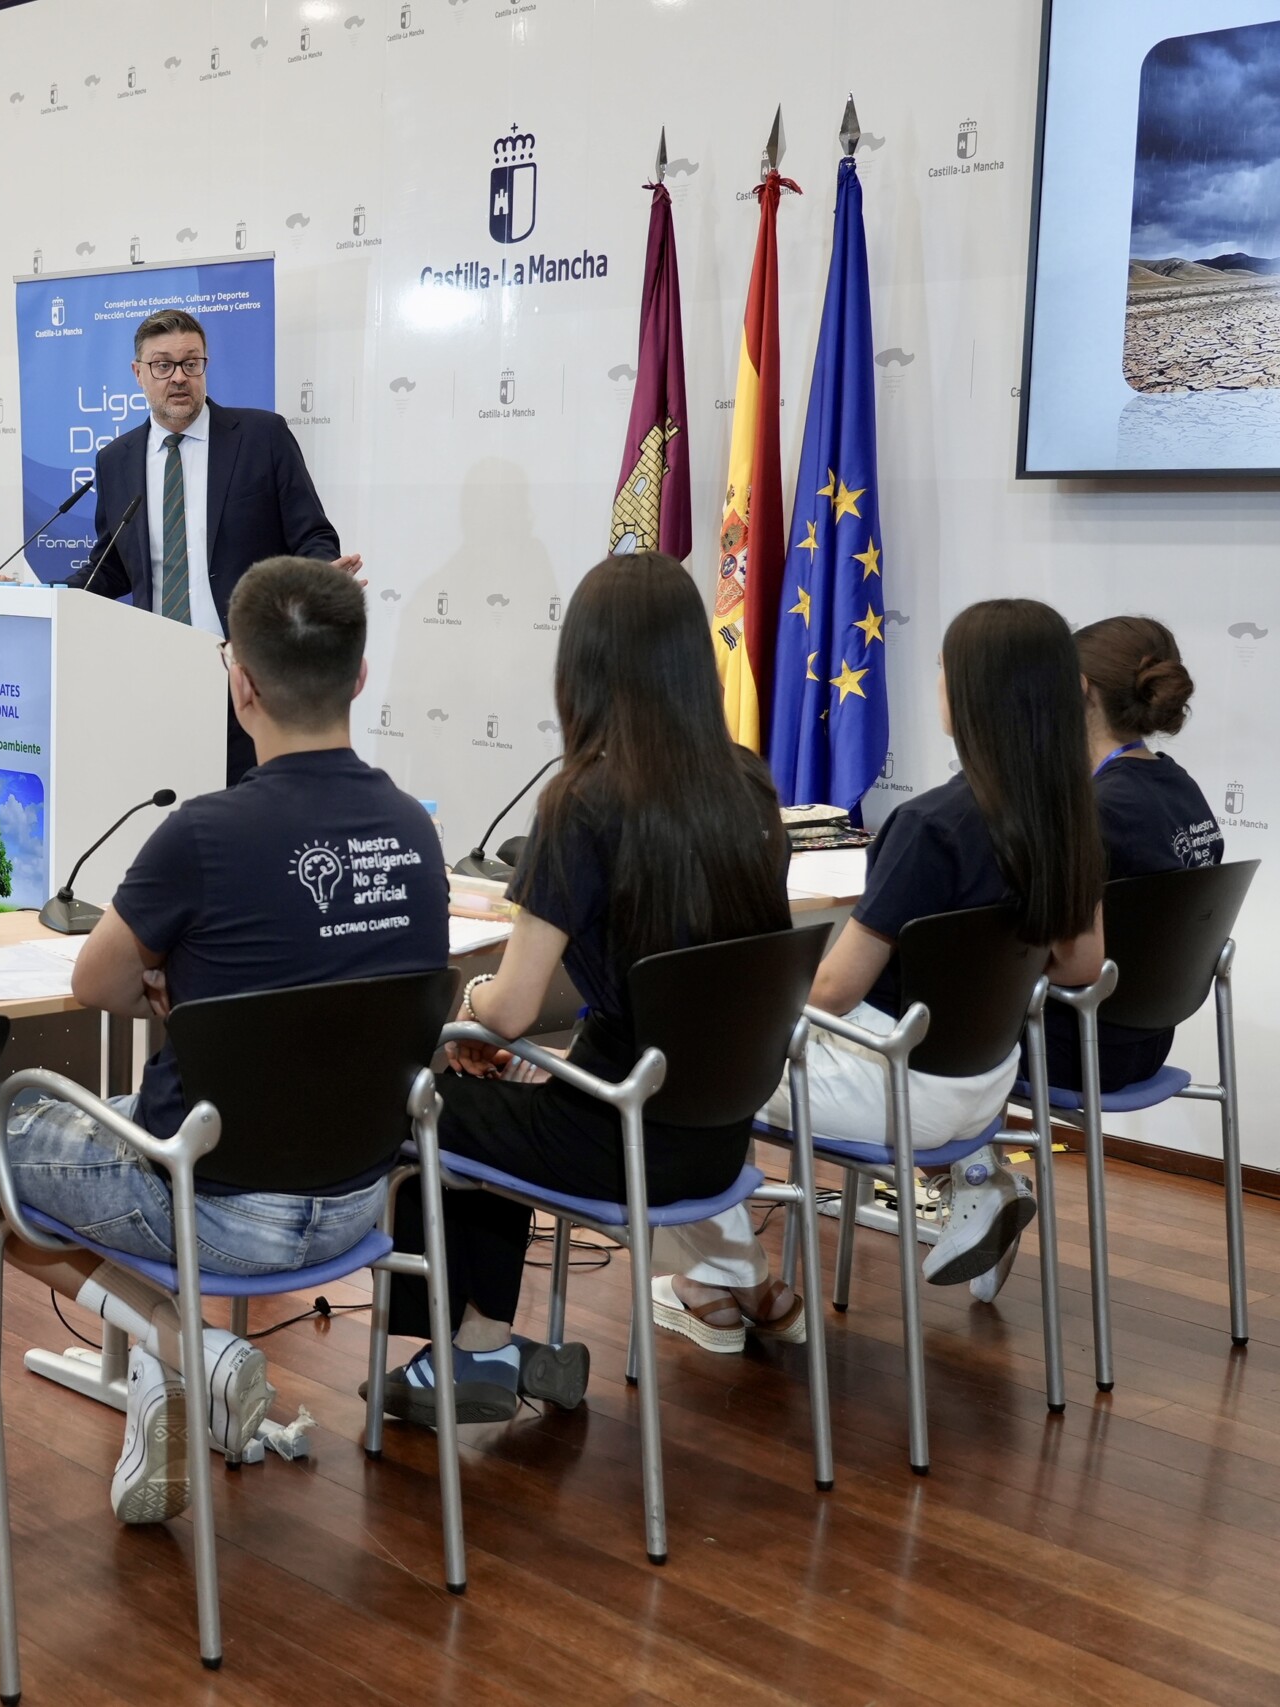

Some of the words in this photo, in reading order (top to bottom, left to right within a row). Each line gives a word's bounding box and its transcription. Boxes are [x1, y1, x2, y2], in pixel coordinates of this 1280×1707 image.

[928, 164, 970, 178] Castilla-La
[973, 160, 1004, 172] Mancha
[336, 239, 361, 250] Castilla-La
[363, 237, 382, 247] Mancha
[528, 249, 608, 285] Mancha
[105, 300, 138, 310] Consejería
[139, 299, 147, 307] de
[186, 293, 211, 304] Cultura
[218, 290, 250, 301] Deportes
[94, 311, 124, 320] Dirección
[125, 309, 150, 318] General
[198, 303, 228, 313] Educativa
[235, 301, 260, 310] Centros
[35, 329, 62, 338] Castilla-La
[63, 328, 82, 336] Mancha
[284, 416, 310, 425] astilla-La
[311, 416, 330, 424] Mancha
[478, 410, 510, 418] Castilla-La
[512, 408, 535, 417] Mancha
[890, 783, 913, 792] Mancha
[1189, 820, 1214, 834] Nuestra
[1240, 818, 1268, 830] Mancha
[348, 837, 399, 853] Nuestra
[350, 849, 422, 872] inteligencia
[353, 872, 370, 888] No
[373, 873, 388, 886] es
[354, 884, 407, 905] artificial
[334, 921, 368, 936] OCTAVIO
[369, 916, 410, 931] CUARTERO
